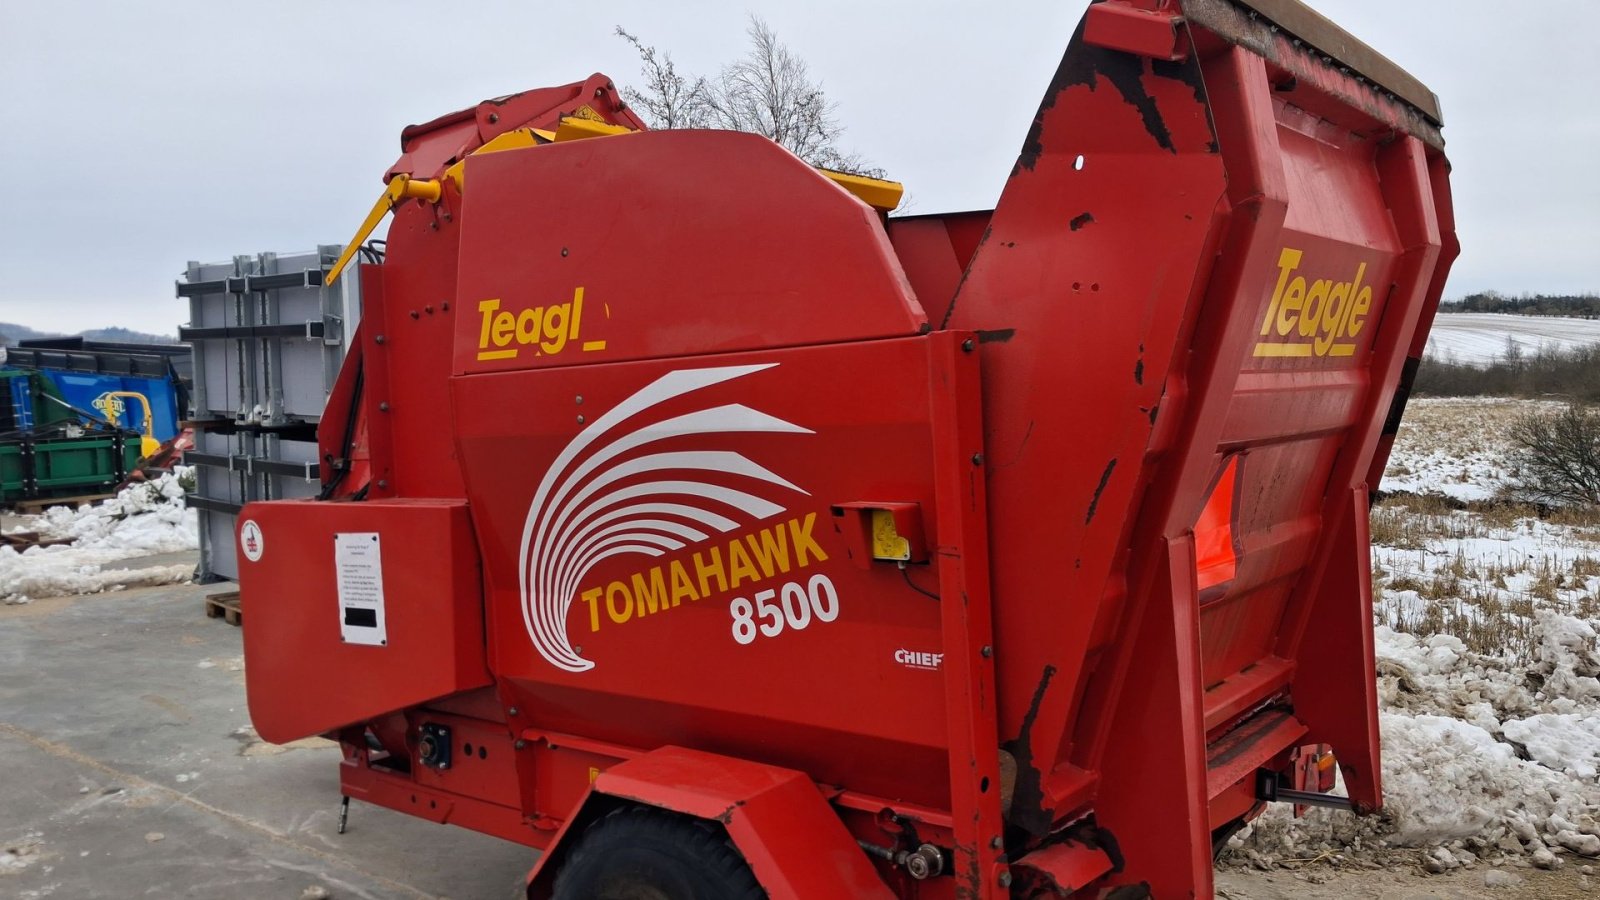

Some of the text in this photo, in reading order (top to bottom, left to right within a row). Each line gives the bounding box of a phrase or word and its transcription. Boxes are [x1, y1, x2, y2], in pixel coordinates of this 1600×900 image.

[478, 286, 609, 355] Teagl
[1260, 248, 1372, 356] Teagle
[581, 512, 829, 632] TOMAHAWK
[729, 573, 840, 645] 8500
[894, 648, 944, 667] CHIEF
